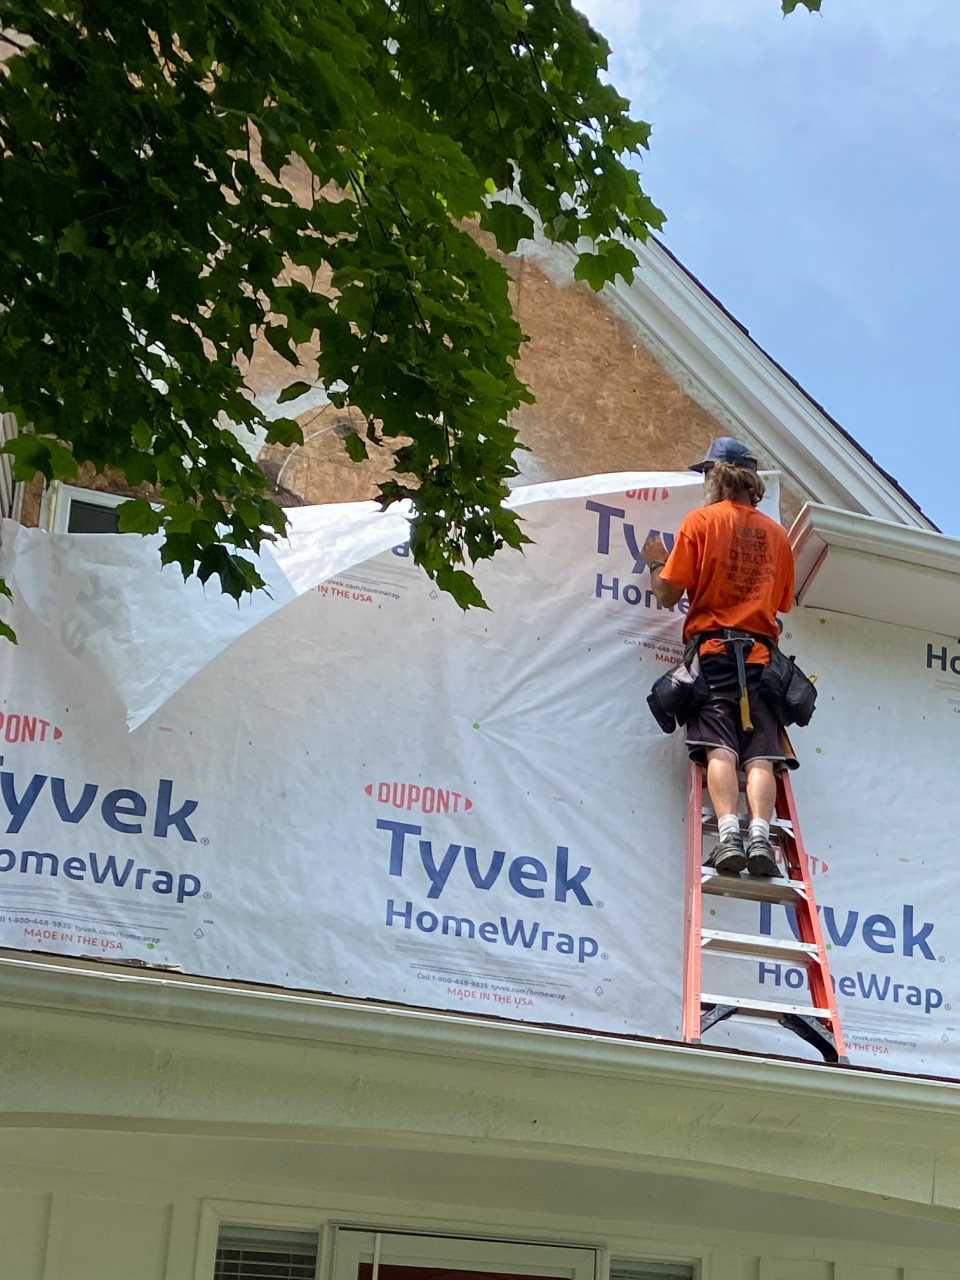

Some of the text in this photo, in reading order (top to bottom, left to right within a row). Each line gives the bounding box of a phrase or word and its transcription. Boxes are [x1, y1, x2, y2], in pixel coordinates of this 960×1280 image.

[317, 584, 373, 603] IN THE USA
[0, 711, 50, 743] ONT
[0, 756, 199, 842] yvek
[377, 781, 462, 814] DUPONT
[376, 818, 594, 907] Tyvek
[8, 917, 72, 930] 1-800-448-9835
[75, 924, 161, 944] tyvek.com/homewrap
[24, 928, 123, 950] MADE IN THE USA
[385, 898, 599, 963] HomeWrap
[432, 975, 488, 989] 1-800-448-9835
[491, 985, 566, 1001] tyvek.com/homewrap
[447, 987, 534, 1007] MADE IN THE USA
[758, 962, 943, 1014] HoeWrap
[851, 1034, 917, 1048] tyvek.com/homewrap
[853, 1043, 870, 1052] THE
[872, 1045, 889, 1055] USA
